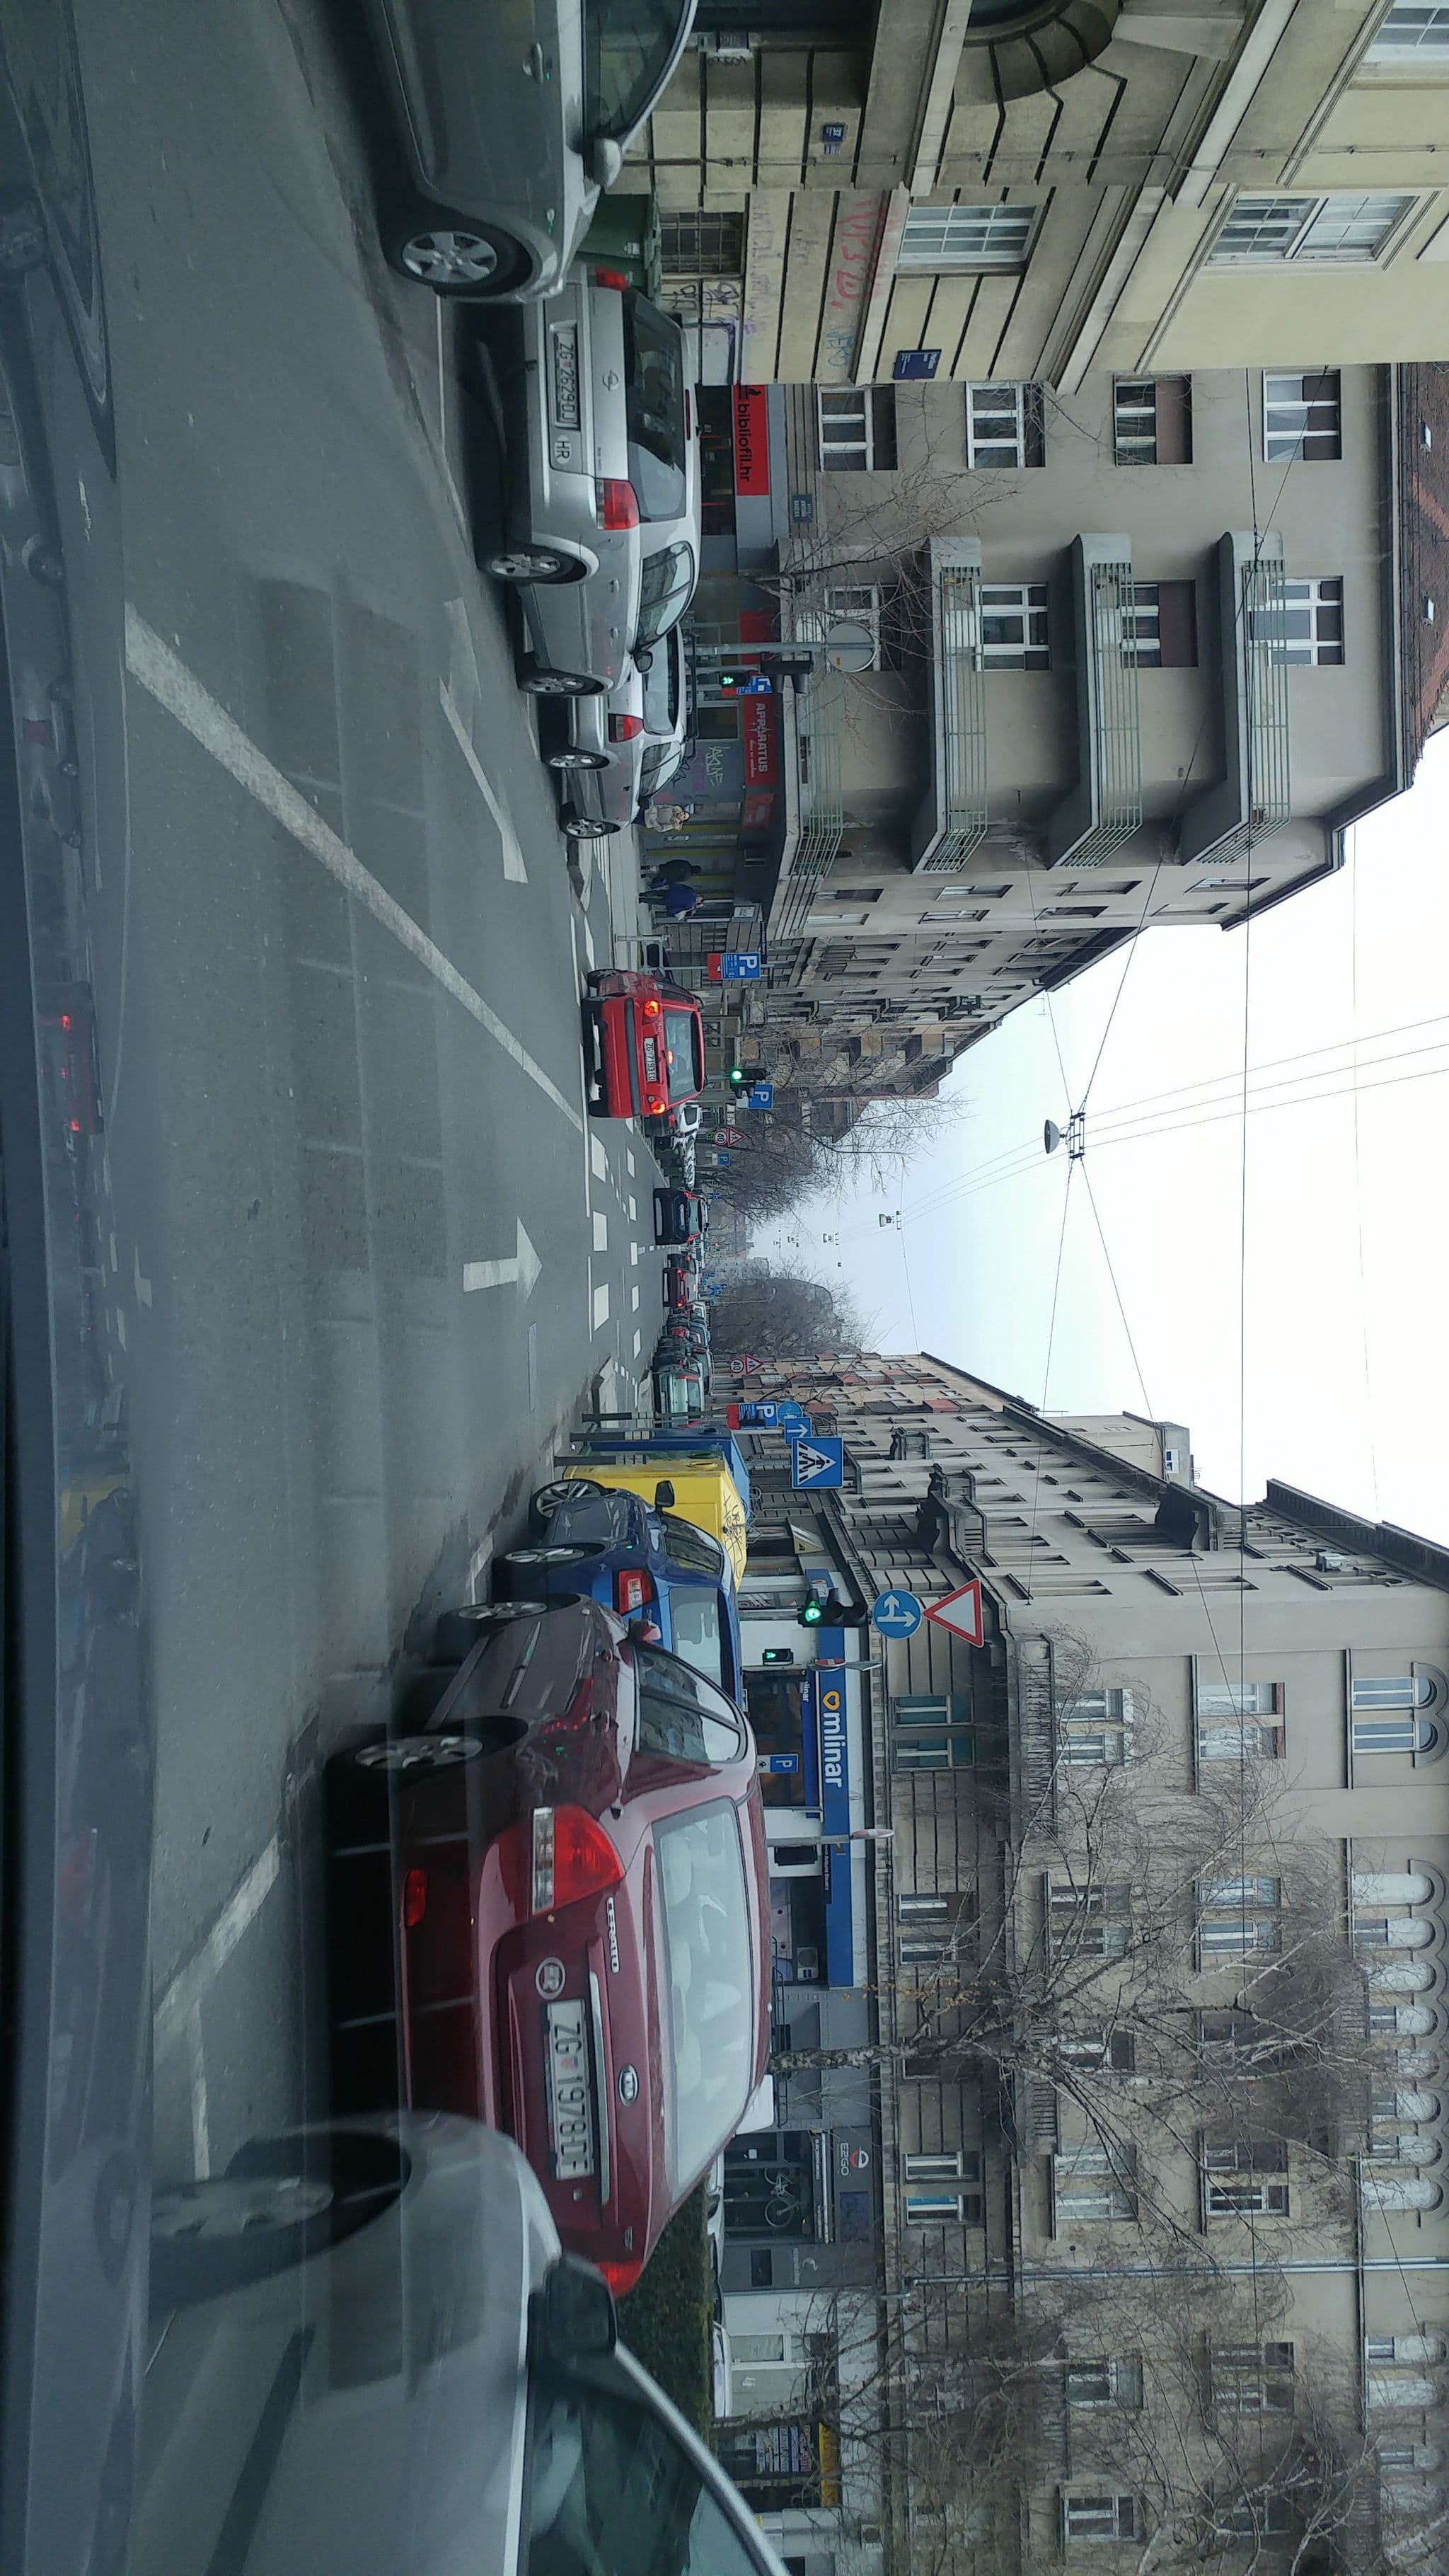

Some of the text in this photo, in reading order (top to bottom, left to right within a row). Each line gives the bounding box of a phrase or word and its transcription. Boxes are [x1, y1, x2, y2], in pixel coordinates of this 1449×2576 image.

[560, 343, 573, 360] ZG
[555, 440, 570, 459] HR
[737, 404, 752, 482] bibliofil.hr
[756, 703, 768, 772] APPARATUS
[739, 955, 758, 969] P
[754, 1091, 769, 1102] P
[717, 1133, 724, 1142] 40
[733, 1361, 741, 1371] 40
[756, 1405, 774, 1418] P
[823, 1712, 845, 1788] mlinar
[775, 1759, 792, 1768] P
[555, 2022, 582, 2054] ZG
[840, 2143, 849, 2176] E2GO
